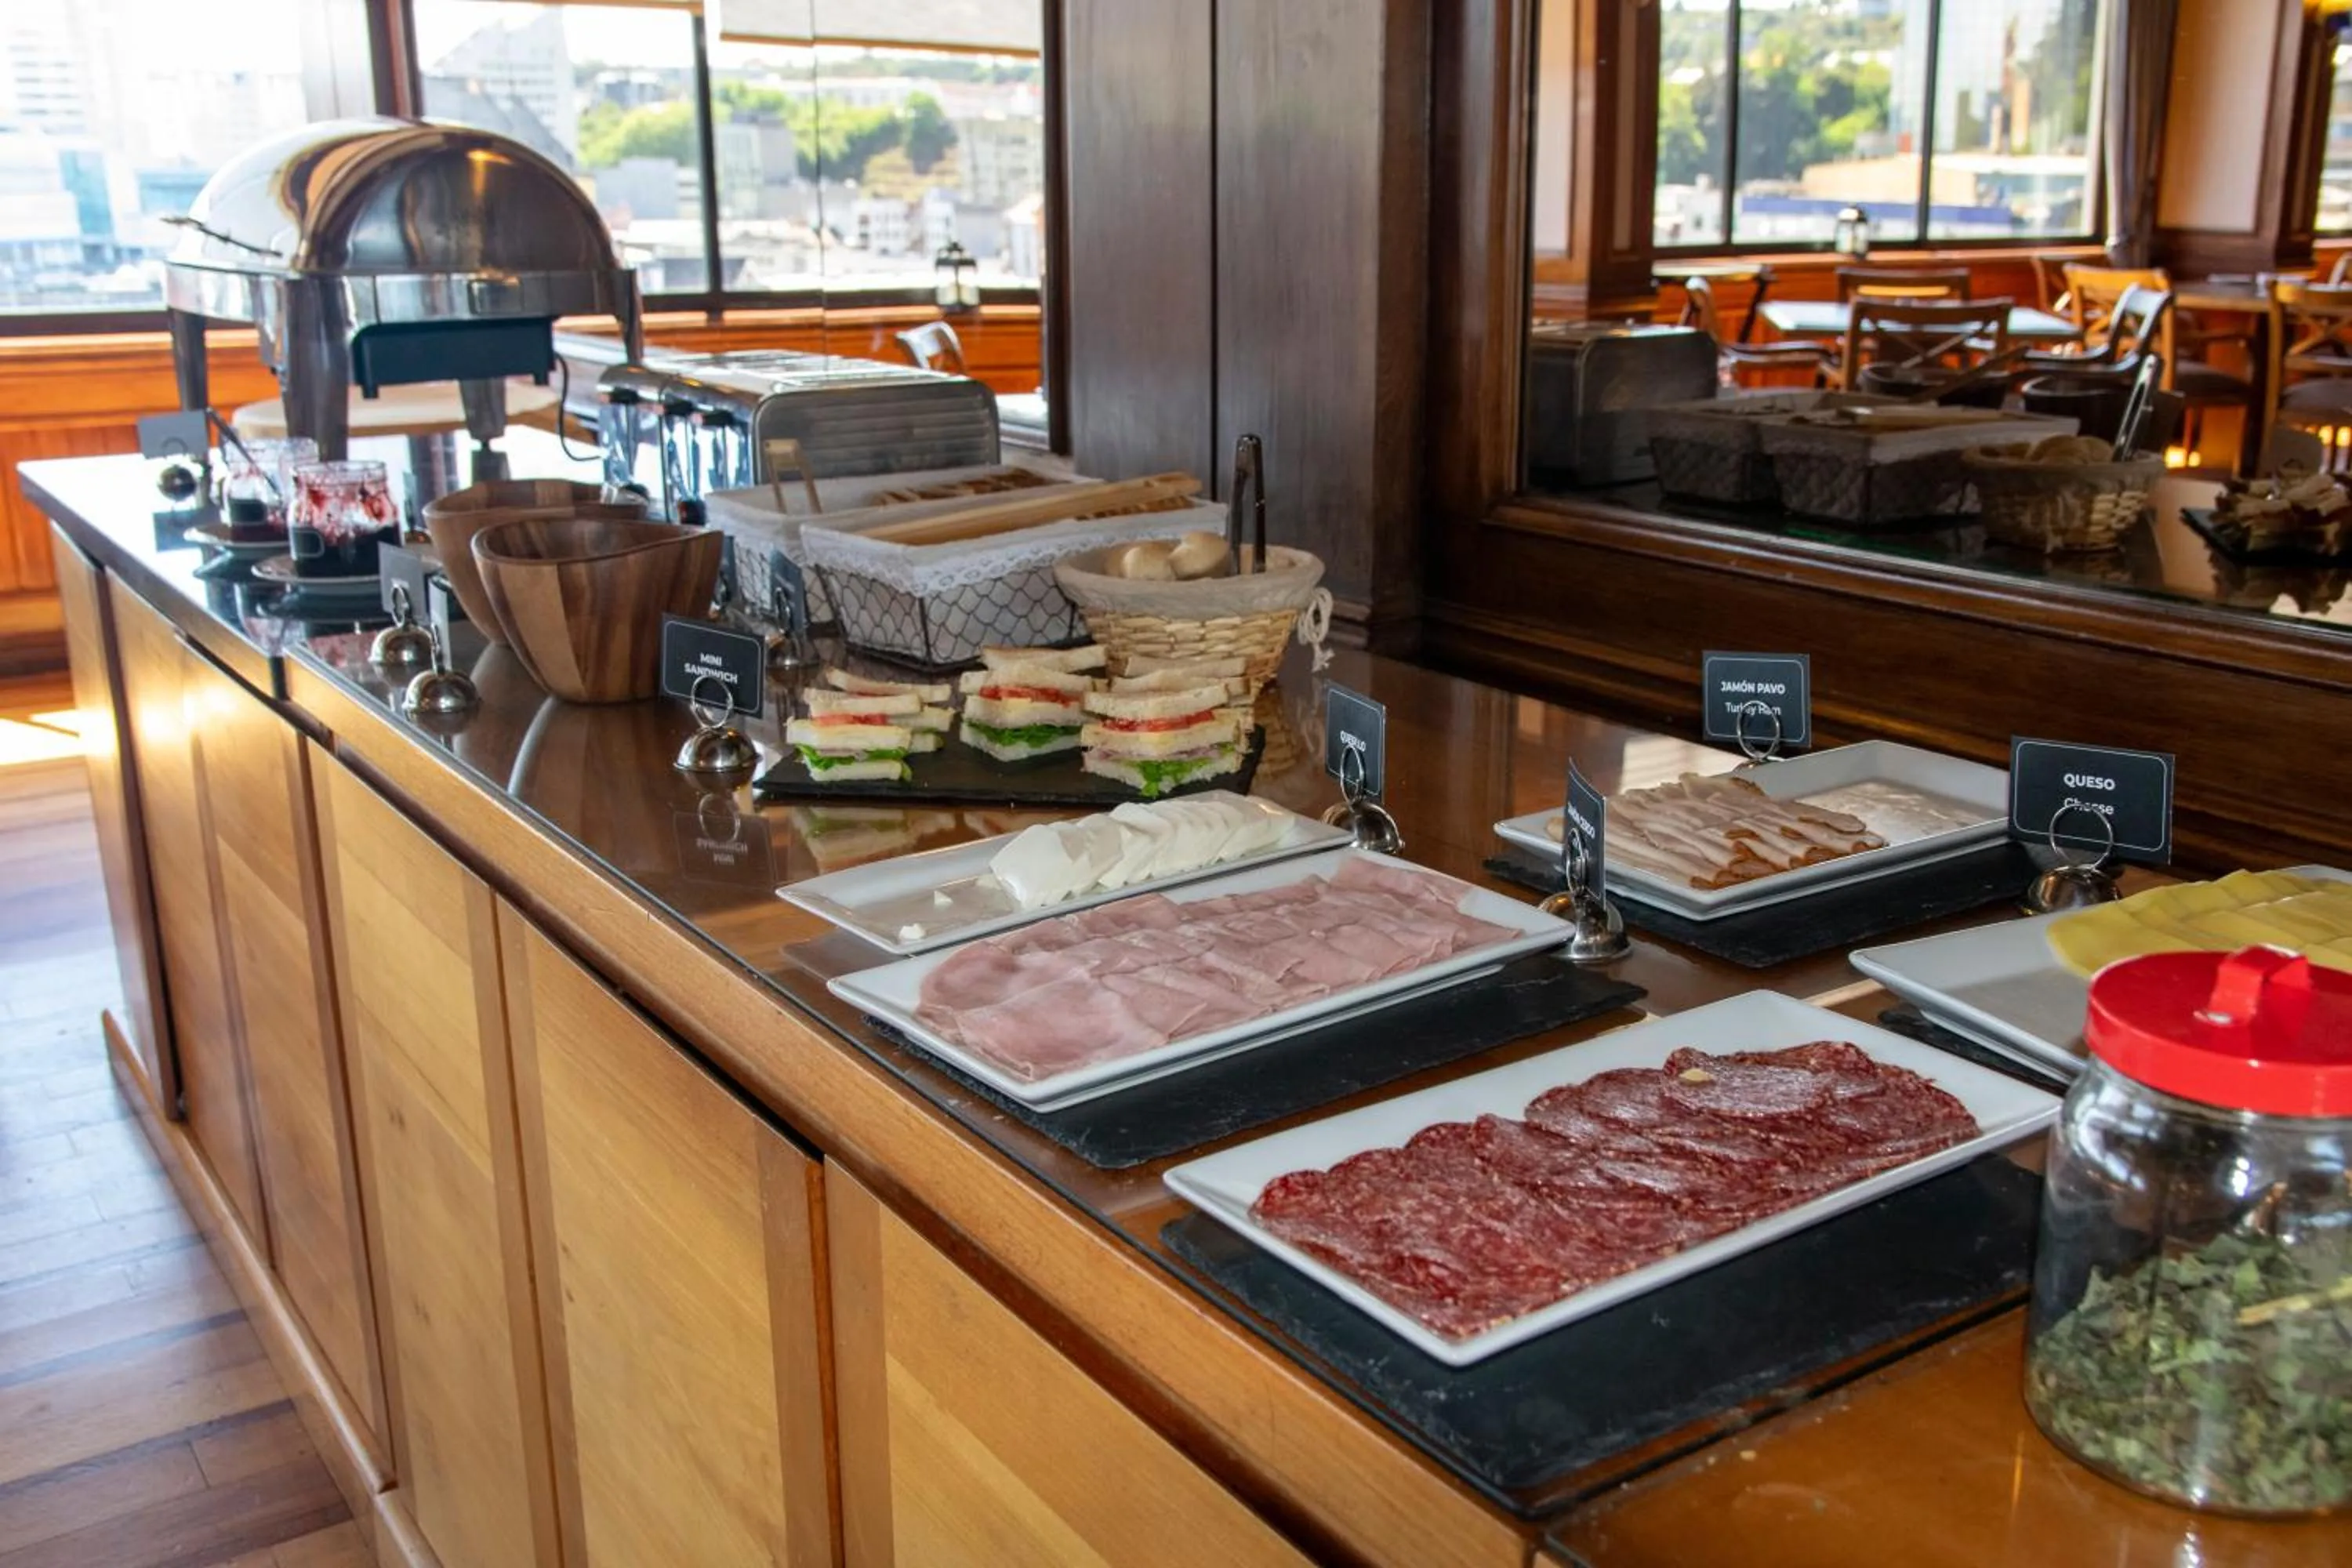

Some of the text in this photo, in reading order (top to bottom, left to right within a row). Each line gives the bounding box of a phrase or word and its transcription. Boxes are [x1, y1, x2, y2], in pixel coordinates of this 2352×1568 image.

[699, 652, 722, 666] MINI
[684, 662, 738, 684] SANDWICH
[1721, 680, 1786, 695] JAMÓN PAVO
[2063, 773, 2116, 791] QUESO
